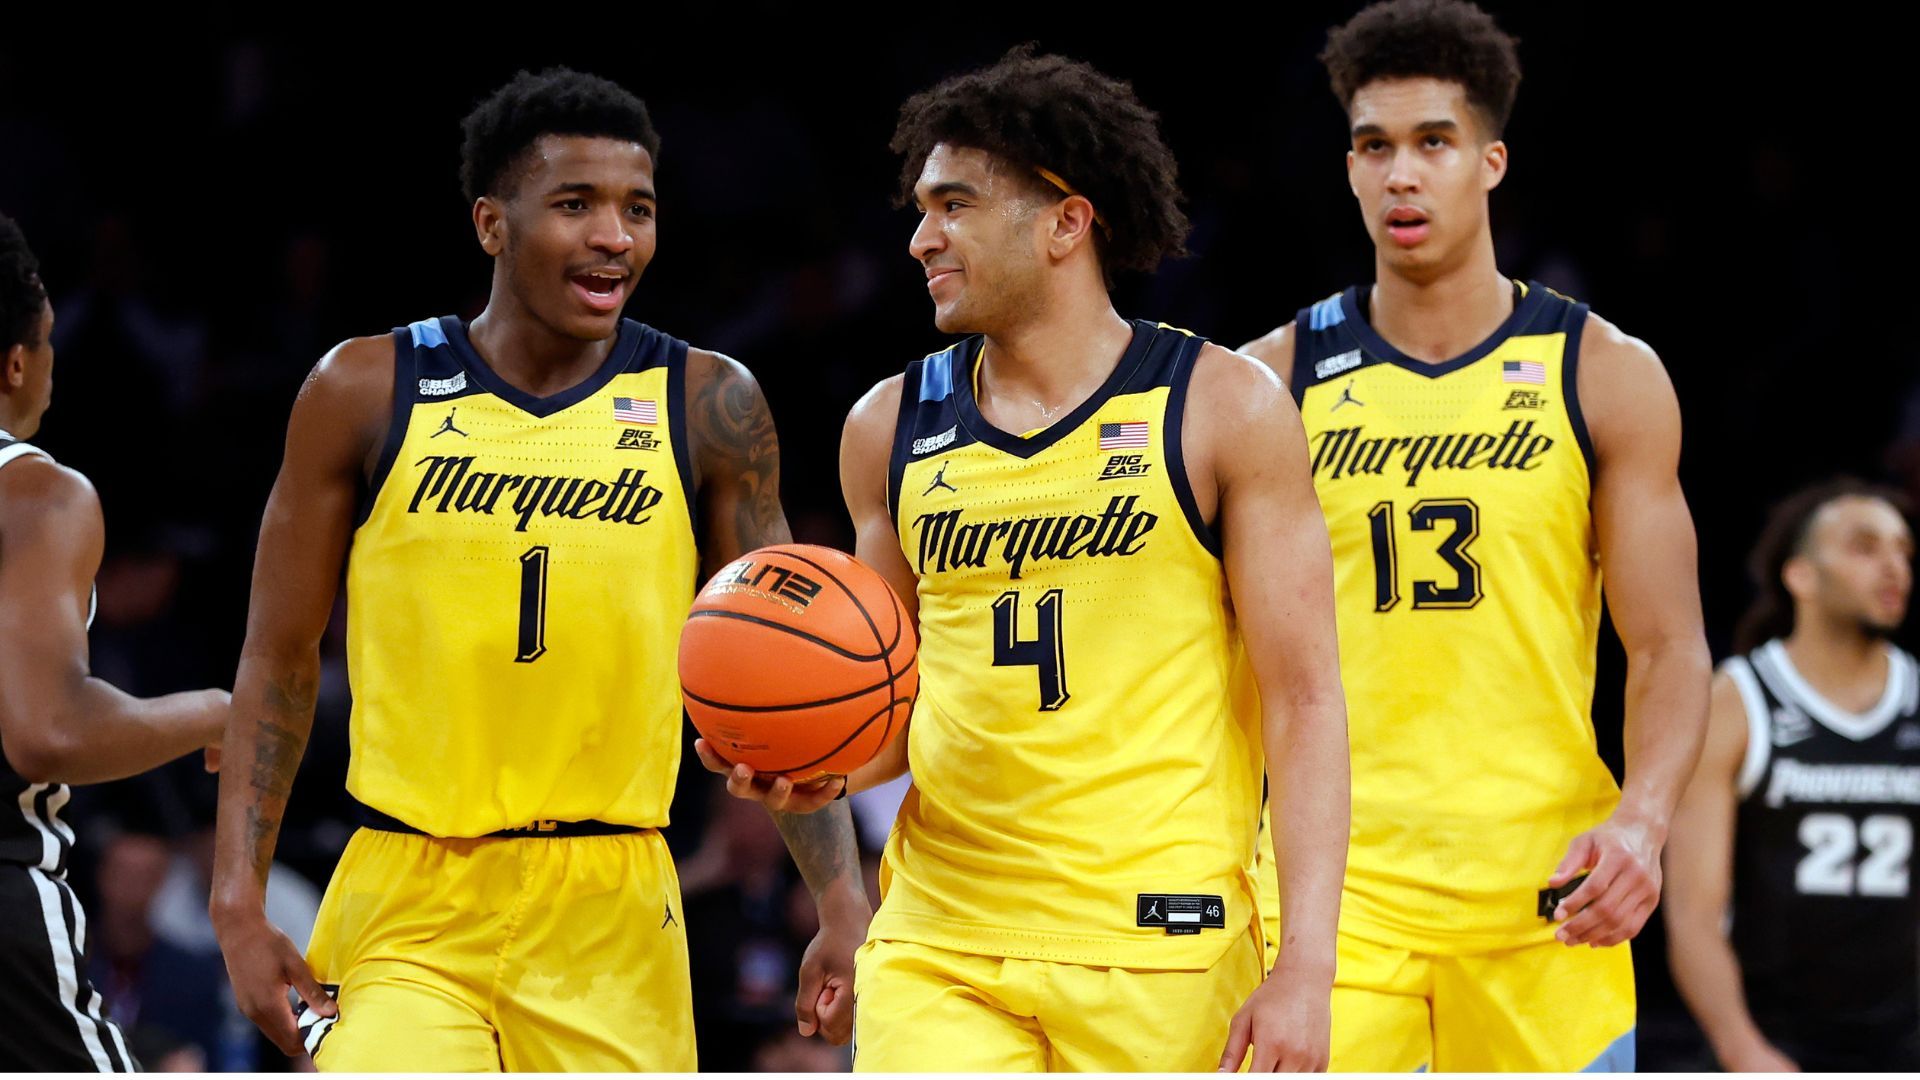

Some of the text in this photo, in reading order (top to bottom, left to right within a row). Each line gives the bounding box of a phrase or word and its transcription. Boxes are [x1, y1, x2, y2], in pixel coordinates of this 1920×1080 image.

[617, 437, 662, 448] EAST
[622, 428, 654, 439] BIG
[1101, 463, 1152, 476] EAST
[1107, 454, 1144, 466] BIG
[1310, 419, 1554, 488] Marquette
[407, 455, 664, 532] Marquette
[912, 495, 1159, 580] Marquette
[1367, 497, 1484, 613] 13
[514, 545, 550, 663] 1
[991, 588, 1071, 712] 4
[1795, 812, 1914, 897] 22
[1205, 904, 1220, 918] 46
